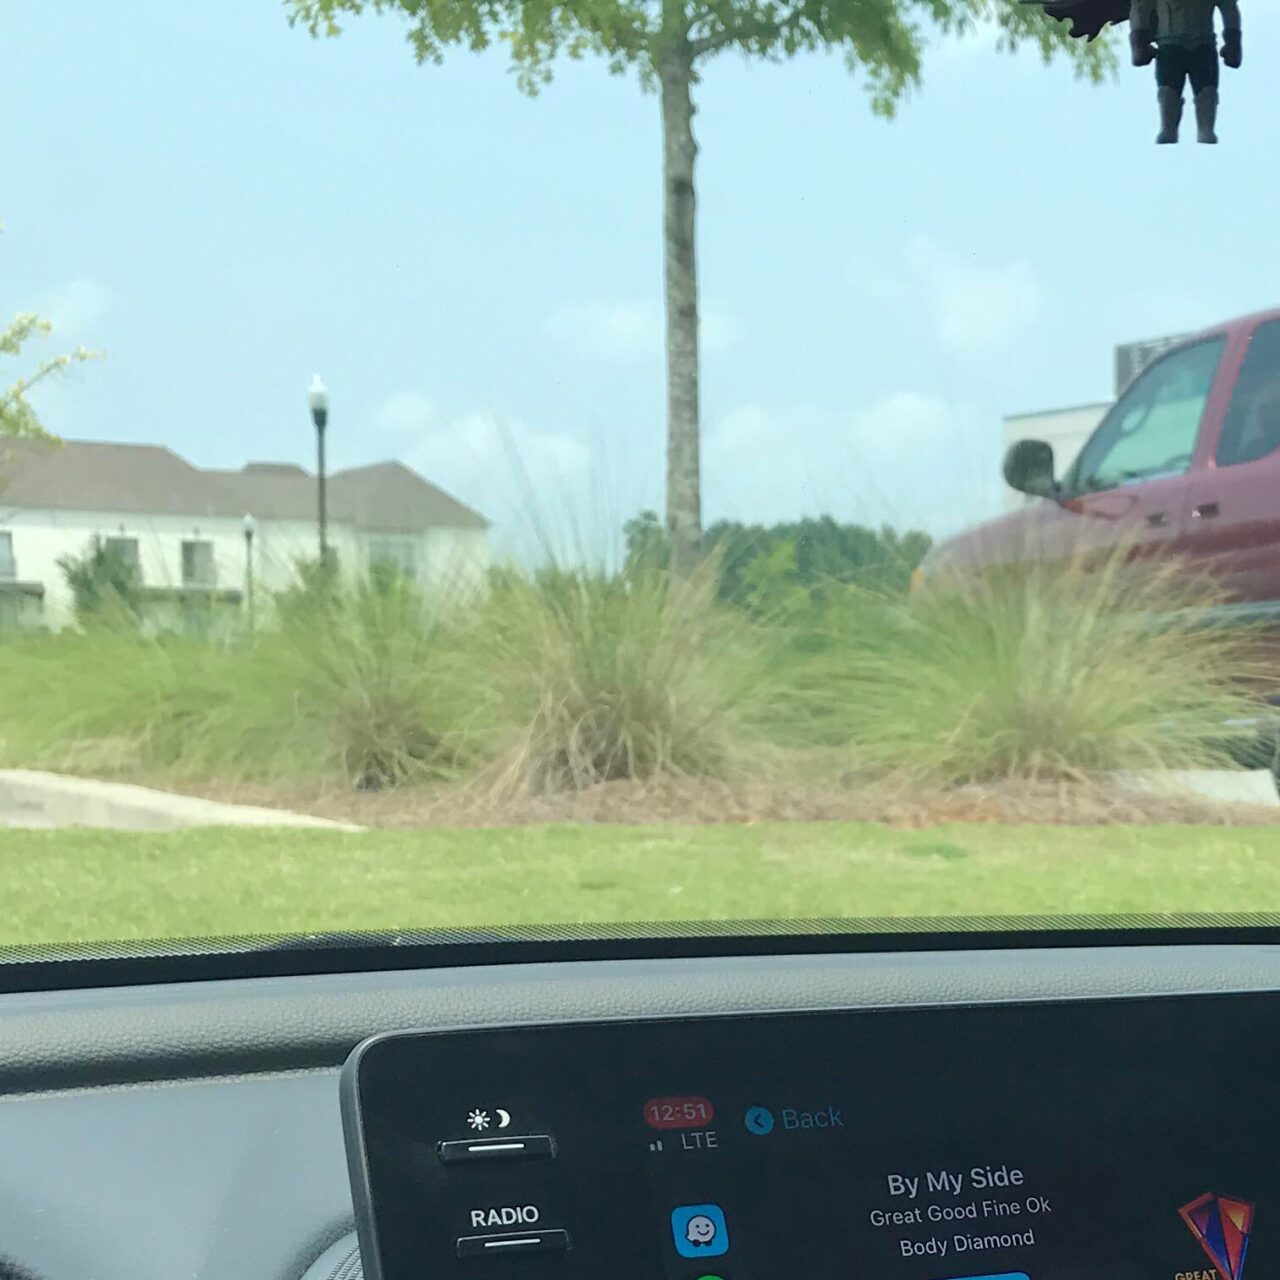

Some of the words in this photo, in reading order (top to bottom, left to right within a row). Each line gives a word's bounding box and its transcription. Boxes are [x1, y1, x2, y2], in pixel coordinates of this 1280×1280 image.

[650, 1103, 708, 1122] 12:51
[782, 1105, 844, 1130] Back
[681, 1131, 719, 1149] LTE
[887, 1174, 918, 1198] By
[926, 1170, 963, 1195] My
[971, 1165, 1025, 1189] Side
[470, 1205, 539, 1228] RADIO
[870, 1207, 922, 1226] Great
[927, 1203, 977, 1221] Good
[982, 1199, 1021, 1218] Fine
[1026, 1196, 1052, 1213] Ok
[900, 1237, 947, 1257] Body
[953, 1229, 1035, 1251] Diamond
